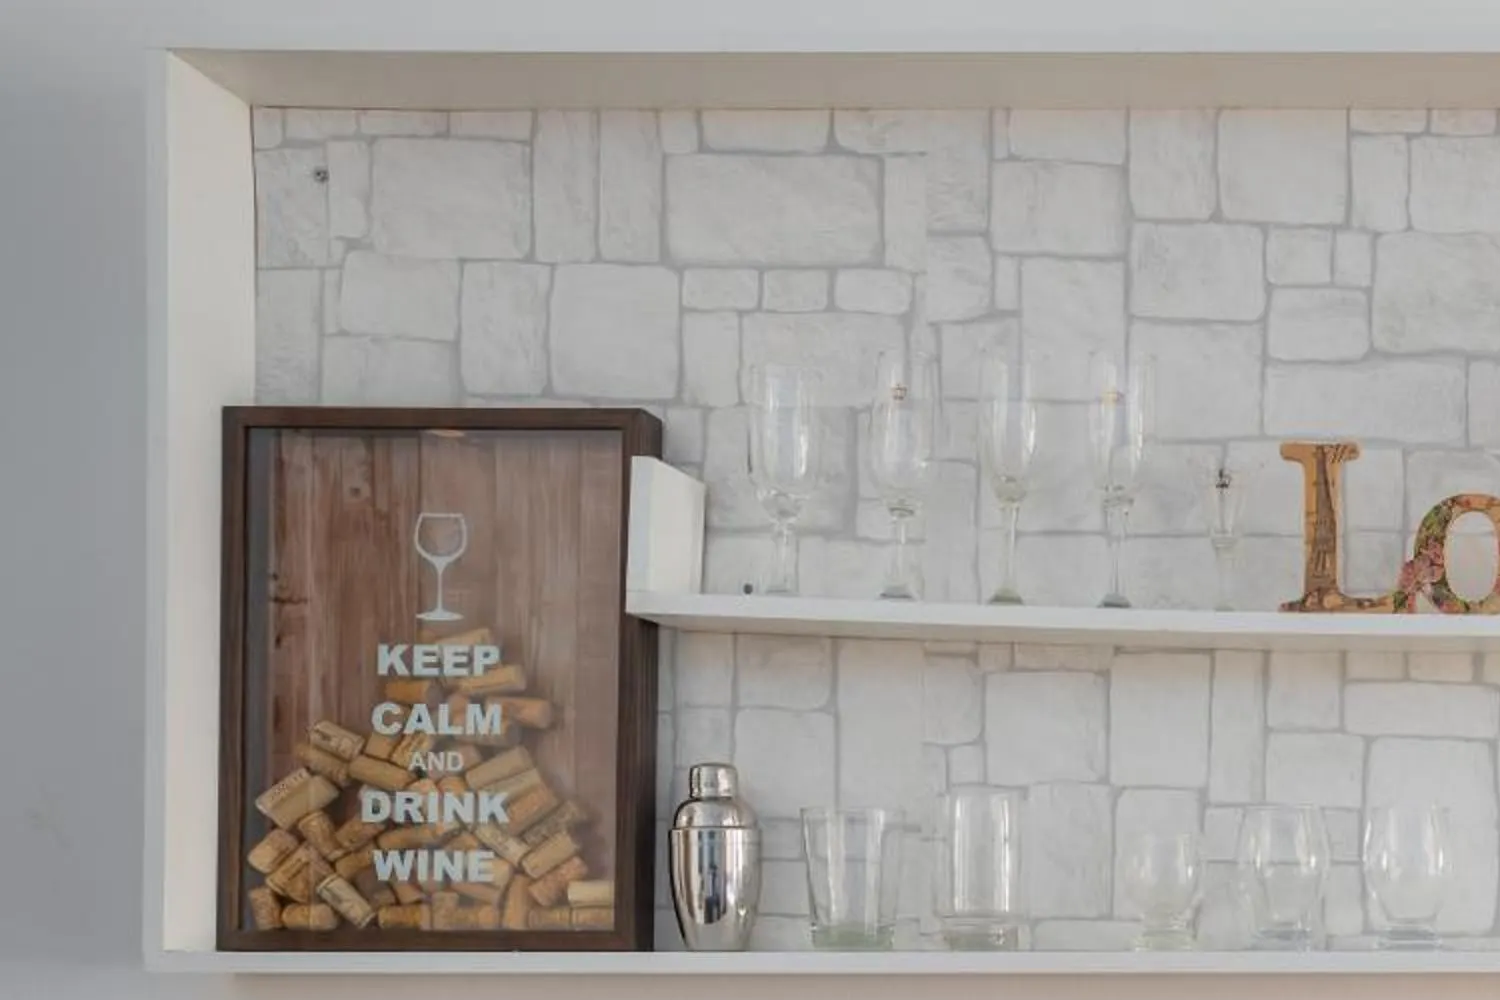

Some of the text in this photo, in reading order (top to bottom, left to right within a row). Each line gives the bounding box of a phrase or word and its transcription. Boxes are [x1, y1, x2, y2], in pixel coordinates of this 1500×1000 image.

[377, 643, 501, 677] KEEP
[371, 701, 503, 736] CALM
[408, 751, 465, 772] AND
[361, 790, 510, 824] DRINK
[373, 850, 497, 882] WINE
